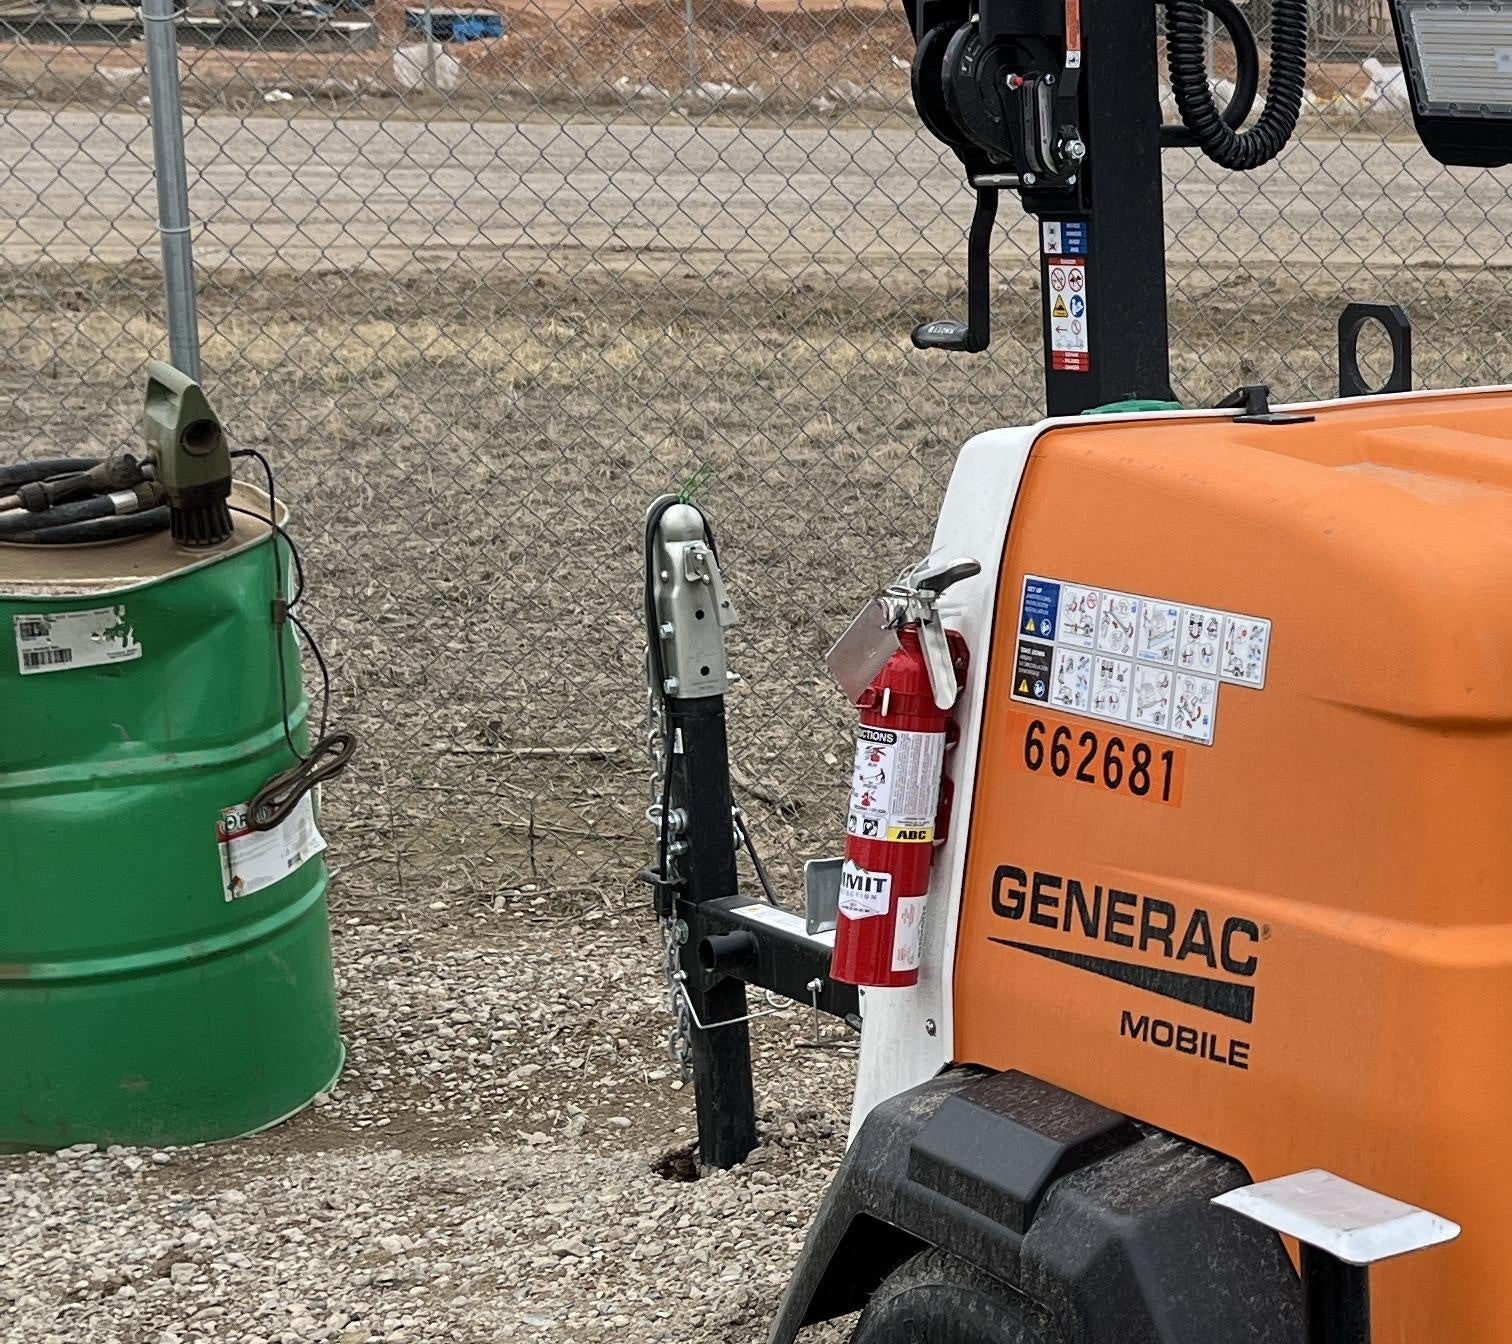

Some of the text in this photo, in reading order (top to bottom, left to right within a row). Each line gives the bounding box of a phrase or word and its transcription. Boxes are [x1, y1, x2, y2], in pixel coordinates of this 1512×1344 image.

[1024, 719, 1176, 803] 662681
[896, 830, 927, 840] ABC
[991, 865, 1260, 978] GENERAC
[1120, 1010, 1251, 1070] MOBILE
